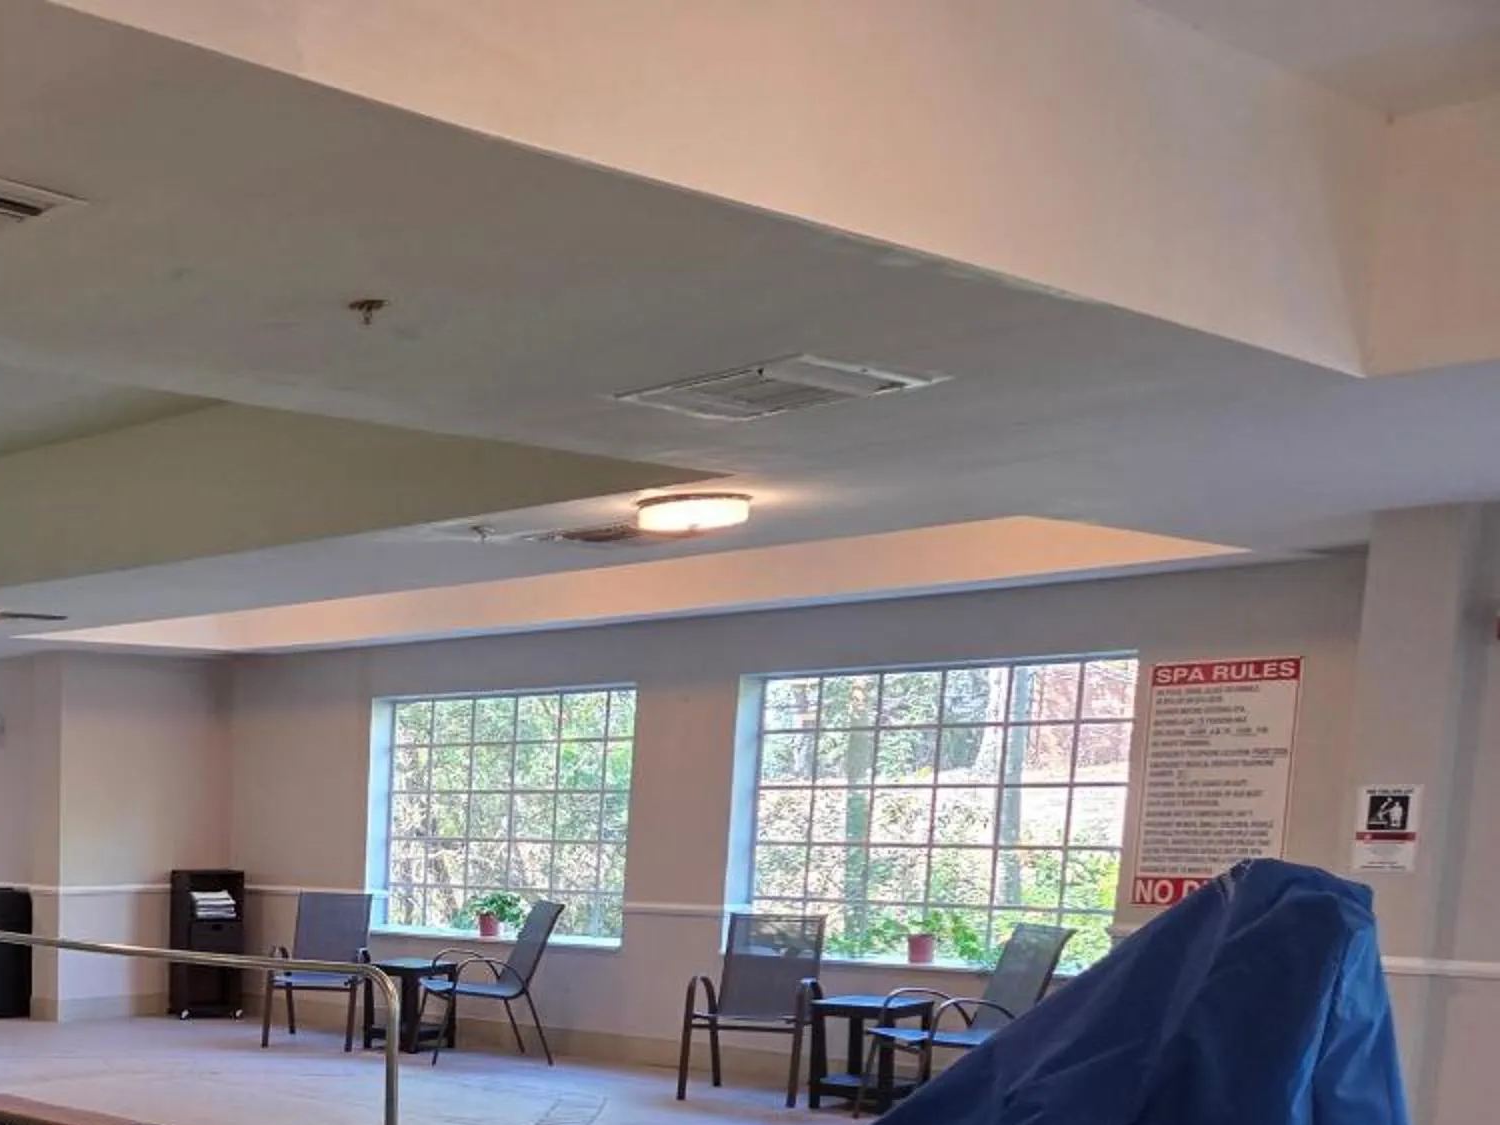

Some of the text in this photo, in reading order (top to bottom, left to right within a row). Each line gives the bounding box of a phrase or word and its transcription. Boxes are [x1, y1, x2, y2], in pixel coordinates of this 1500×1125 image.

[1155, 660, 1297, 684] SPA RULES
[1134, 878, 1175, 904] NO
